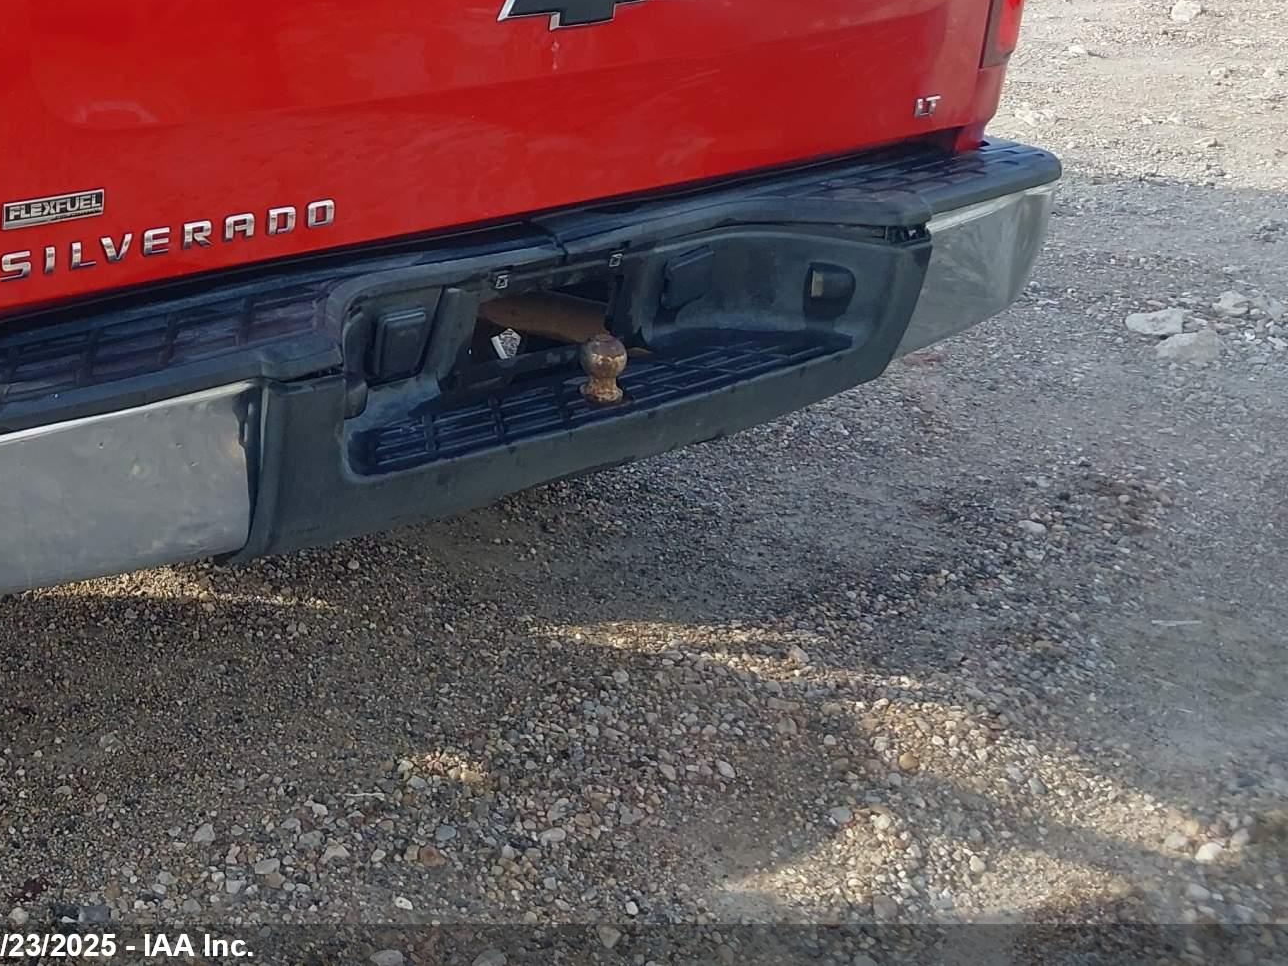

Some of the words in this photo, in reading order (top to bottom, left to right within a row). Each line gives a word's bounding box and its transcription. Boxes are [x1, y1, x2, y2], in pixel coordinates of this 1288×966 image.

[914, 95, 941, 118] LT
[8, 194, 102, 221] FLEXFUEL
[0, 198, 336, 282] SILVERADO
